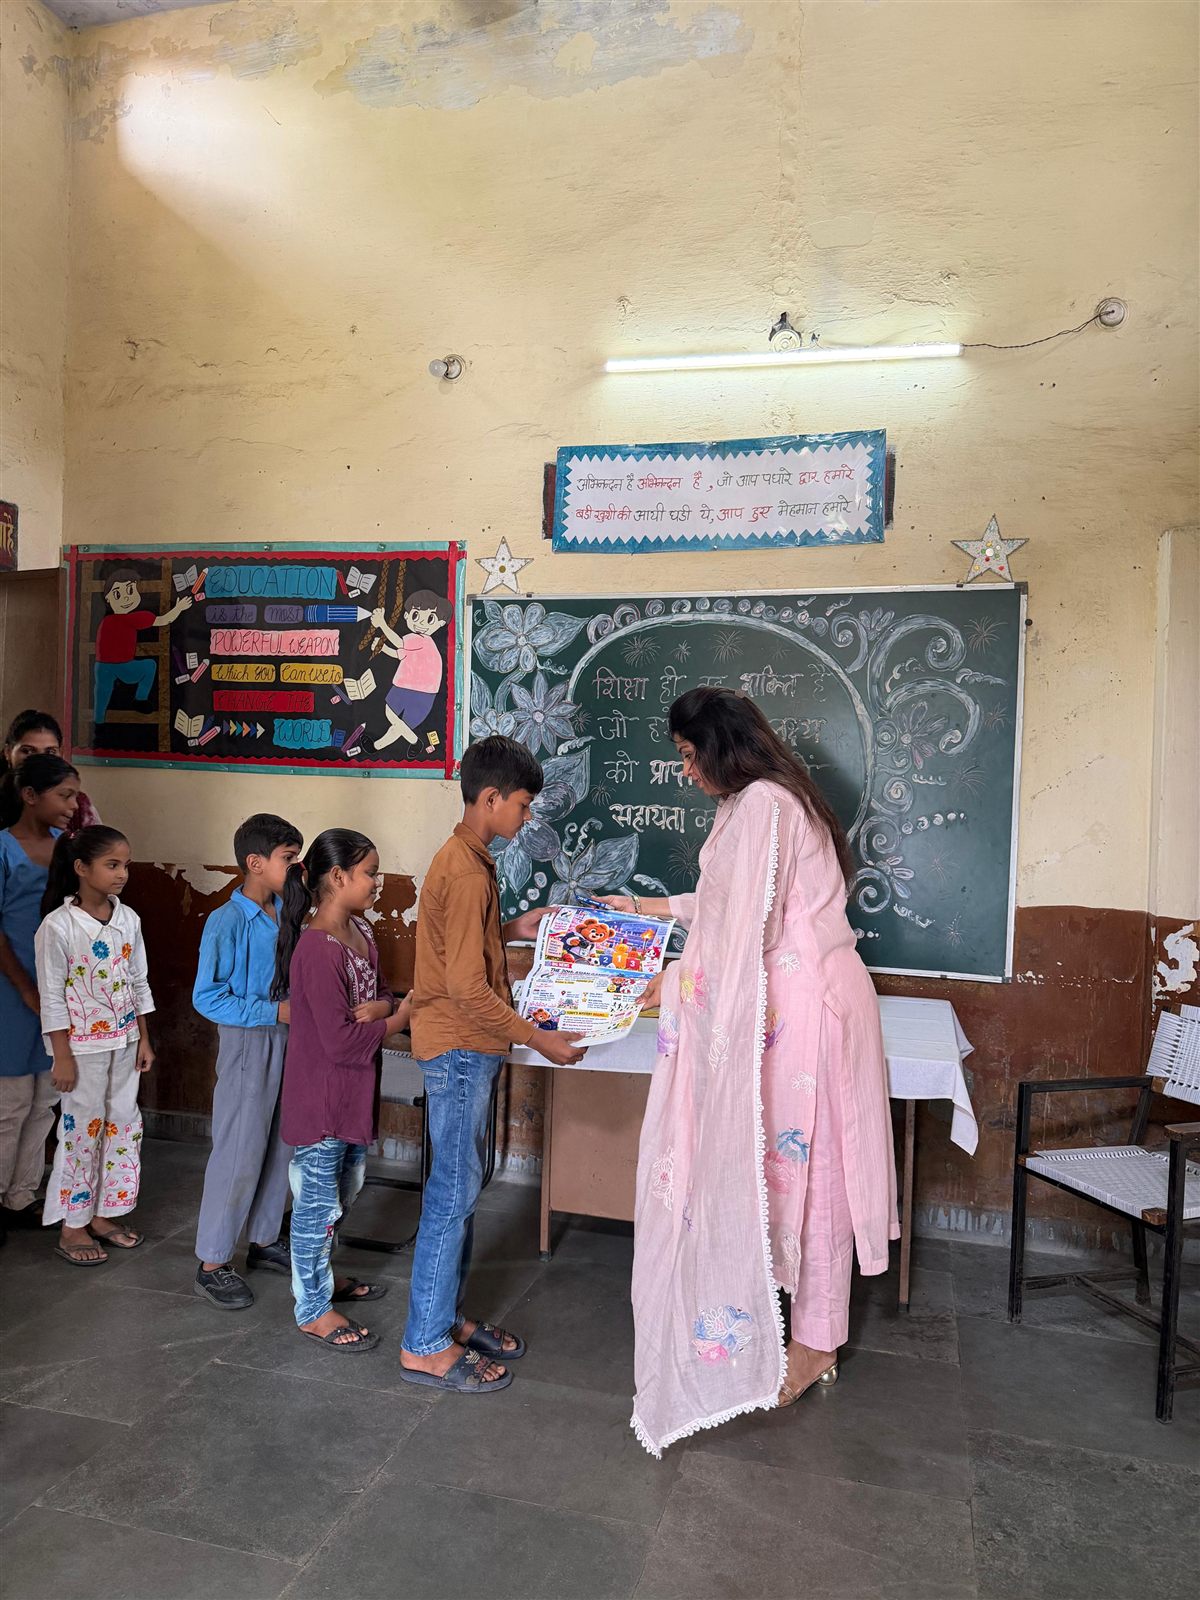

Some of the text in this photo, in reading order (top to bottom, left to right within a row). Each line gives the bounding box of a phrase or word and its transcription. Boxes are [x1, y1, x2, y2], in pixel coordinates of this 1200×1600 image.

[717, 471, 733, 487] जो
[736, 473, 760, 487] आप
[761, 467, 793, 486] पधारे
[799, 471, 819, 485] द्वार
[823, 464, 855, 485] हमारे
[633, 502, 667, 522] आयी
[717, 506, 744, 521] आप
[777, 500, 820, 517] मेहमान
[821, 495, 853, 516] हमारे
[210, 567, 335, 597] EDUCATION
[211, 606, 228, 621] is
[231, 604, 254, 621] the
[212, 630, 339, 655] POWERFUL WEAPON
[592, 666, 650, 701] शिक्षा
[660, 665, 687, 703] ही
[217, 693, 313, 711] CHANGE THE
[275, 720, 331, 742] WORLD
[597, 709, 640, 740] जो
[603, 750, 640, 784] को
[608, 803, 685, 833] सहायता
